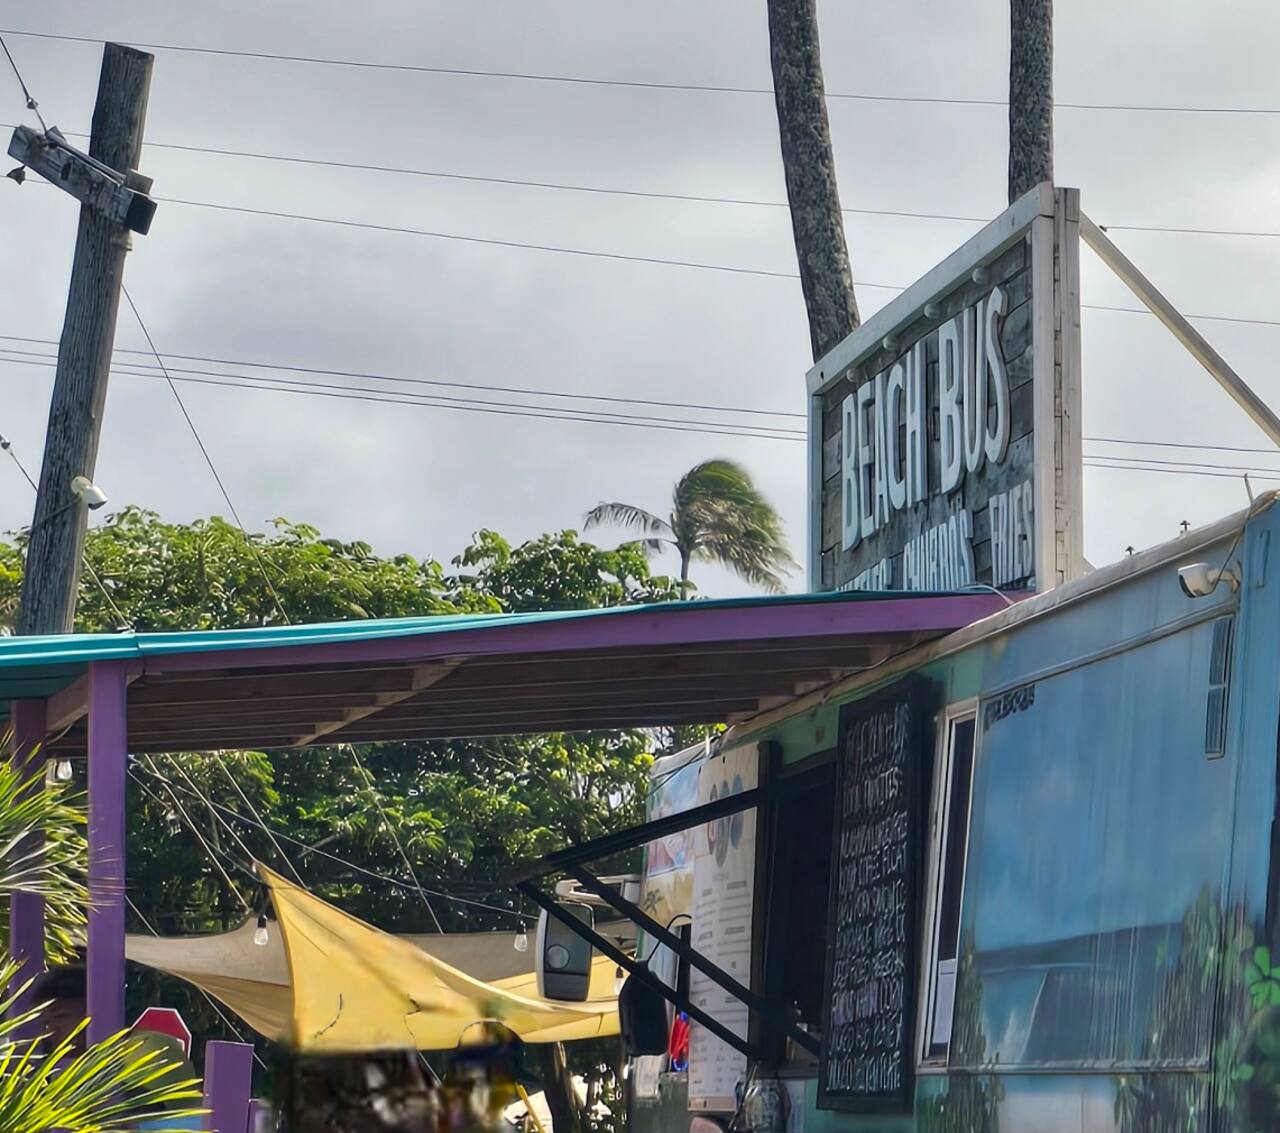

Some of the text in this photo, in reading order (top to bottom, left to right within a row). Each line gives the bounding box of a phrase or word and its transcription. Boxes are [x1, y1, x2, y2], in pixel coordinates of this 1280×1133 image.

[841, 287, 1011, 552] BEACH BUS
[988, 479, 1035, 588] FRIES
